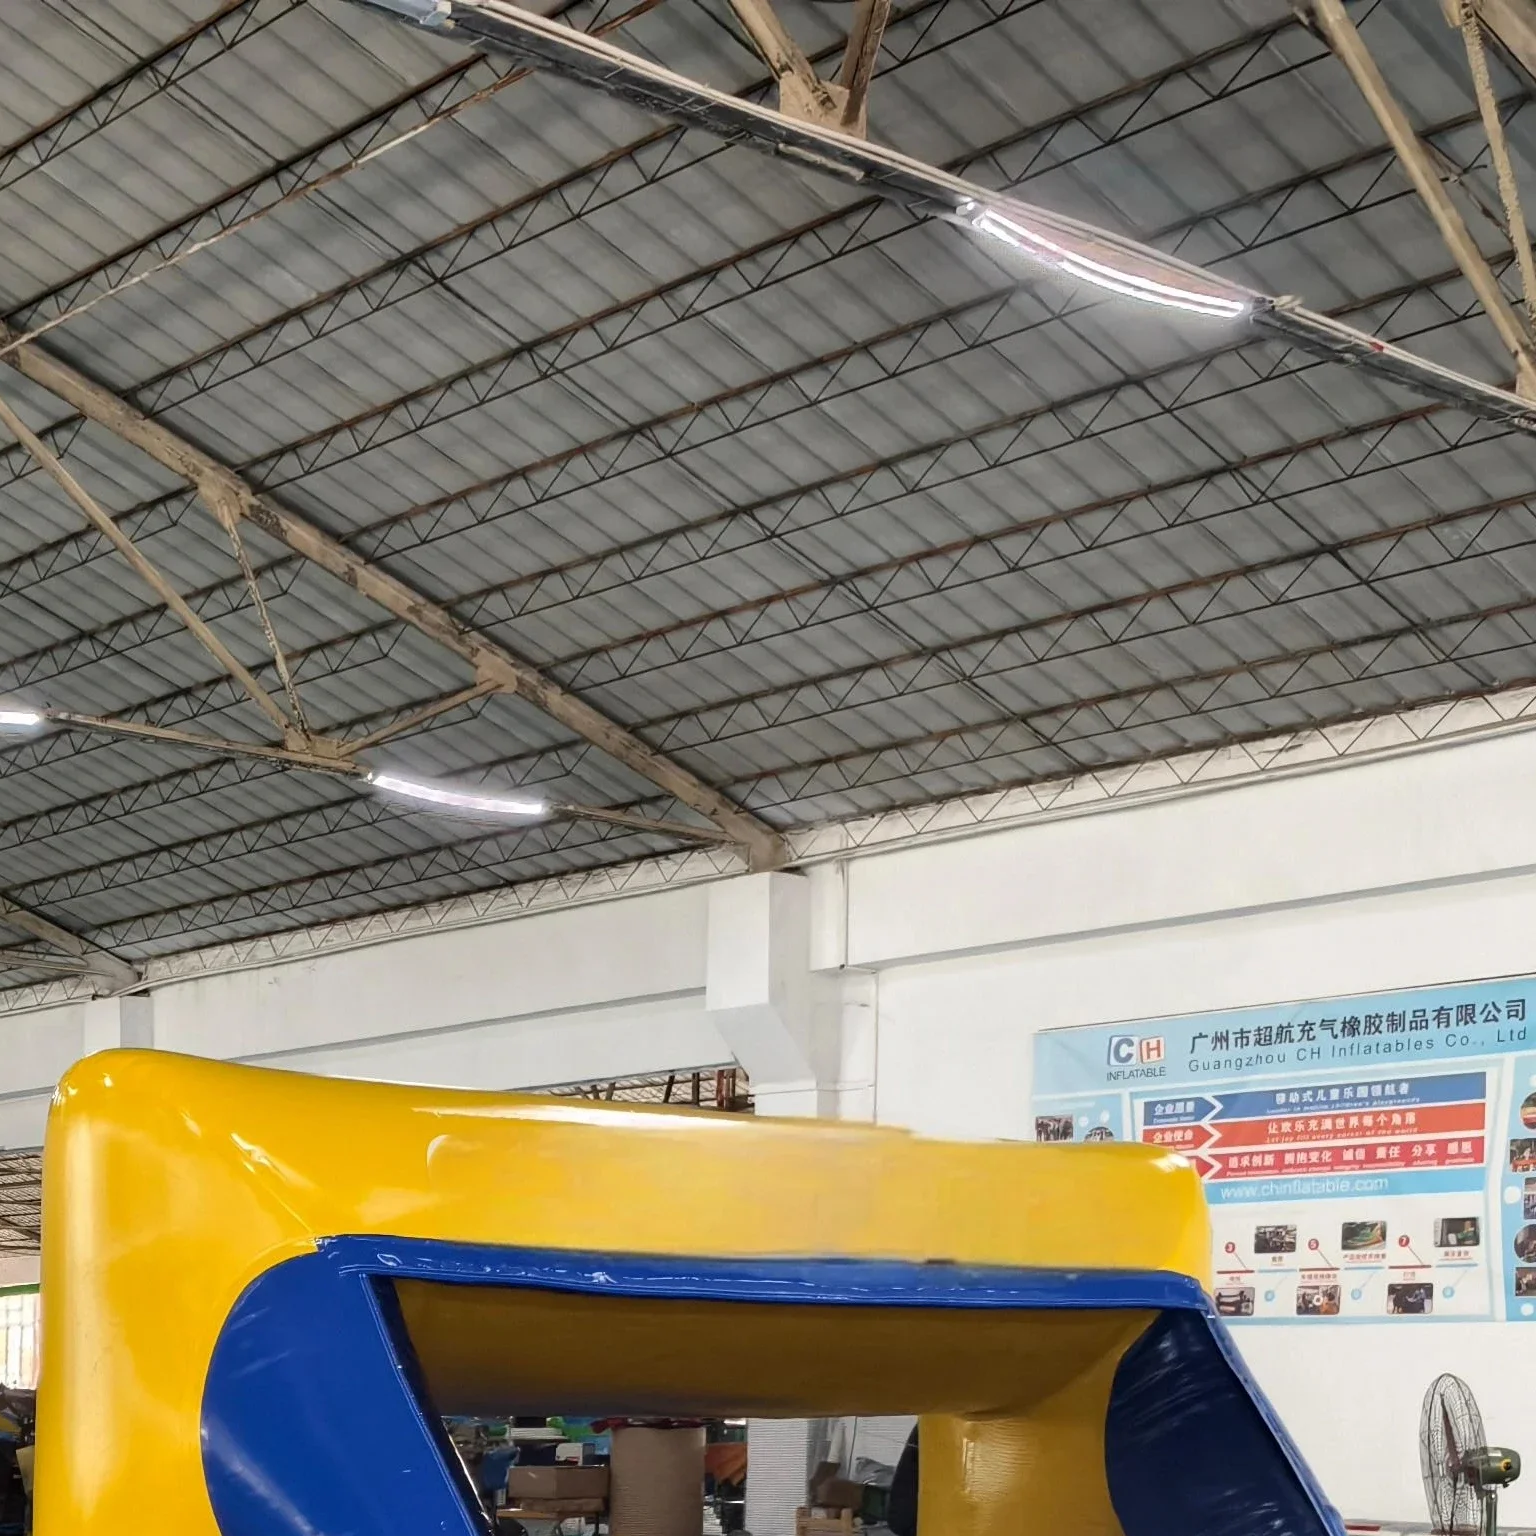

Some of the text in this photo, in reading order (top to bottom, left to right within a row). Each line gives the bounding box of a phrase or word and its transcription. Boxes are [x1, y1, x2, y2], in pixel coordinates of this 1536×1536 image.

[1189, 998, 1526, 1054] 广州市超航充气橡胶制品有限公司
[1113, 1038, 1162, 1064] CH
[1188, 1053, 1286, 1072] Guangzhou
[1296, 1047, 1321, 1061] CH
[1331, 1038, 1434, 1058] Inflatables
[1496, 1026, 1527, 1043] Ltd
[1106, 1066, 1167, 1081] INFLATABLE
[1220, 1177, 1389, 1200] www.chinflatable.com
